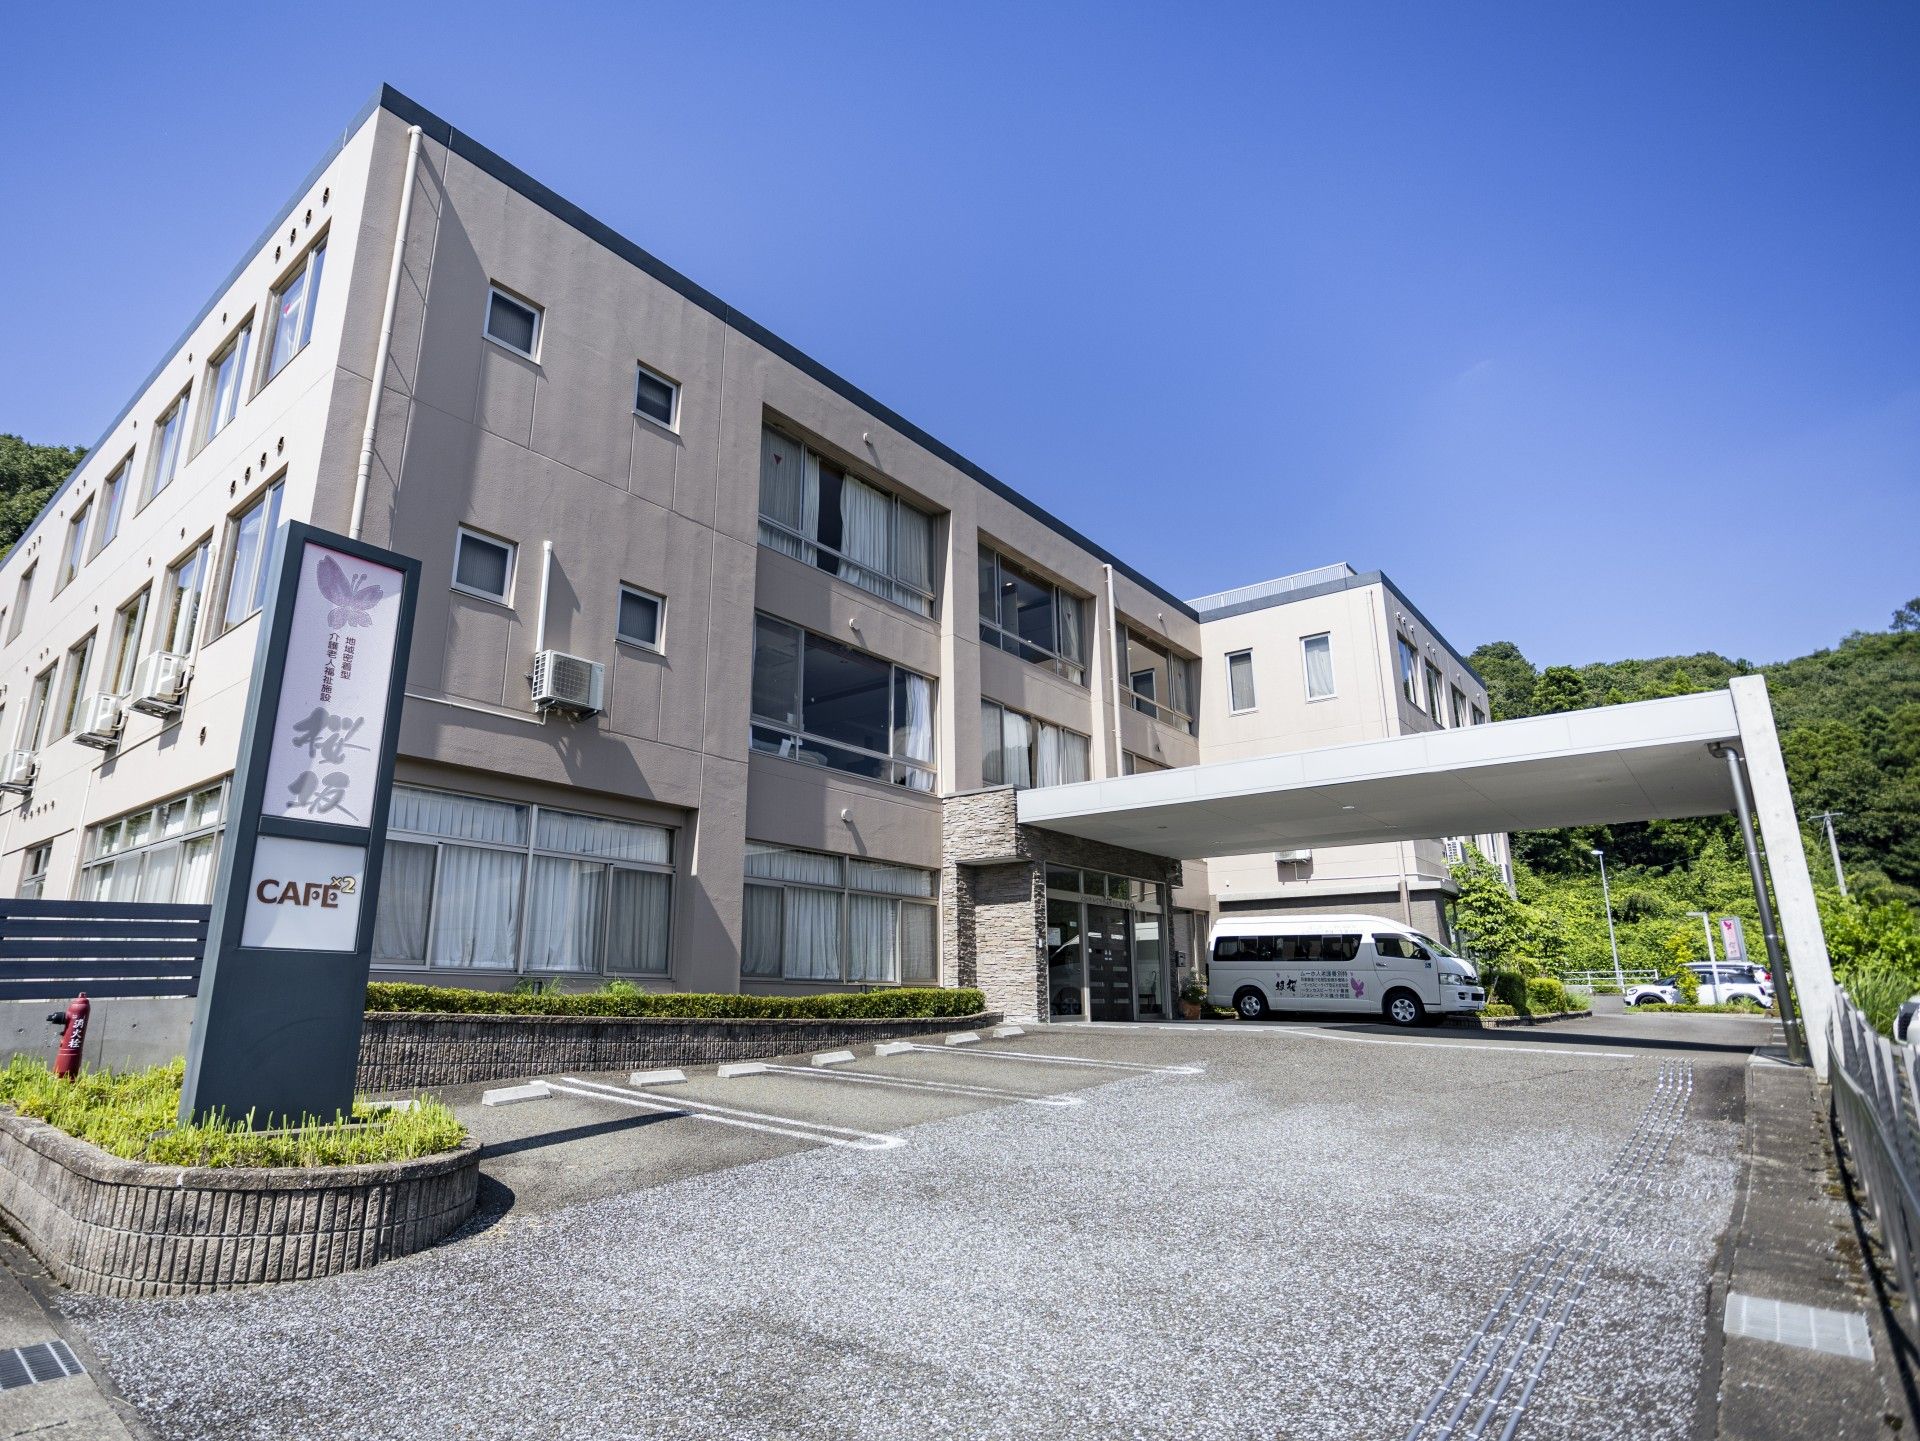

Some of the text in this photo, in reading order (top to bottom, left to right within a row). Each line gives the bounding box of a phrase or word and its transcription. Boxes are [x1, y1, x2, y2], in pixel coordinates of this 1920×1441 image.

[320, 632, 340, 702] 介護老人福祉施設
[340, 637, 356, 680] 地域密着型
[286, 707, 371, 821] 桜坂
[256, 879, 340, 908] CAFE
[68, 1018, 84, 1048] 消火栓
